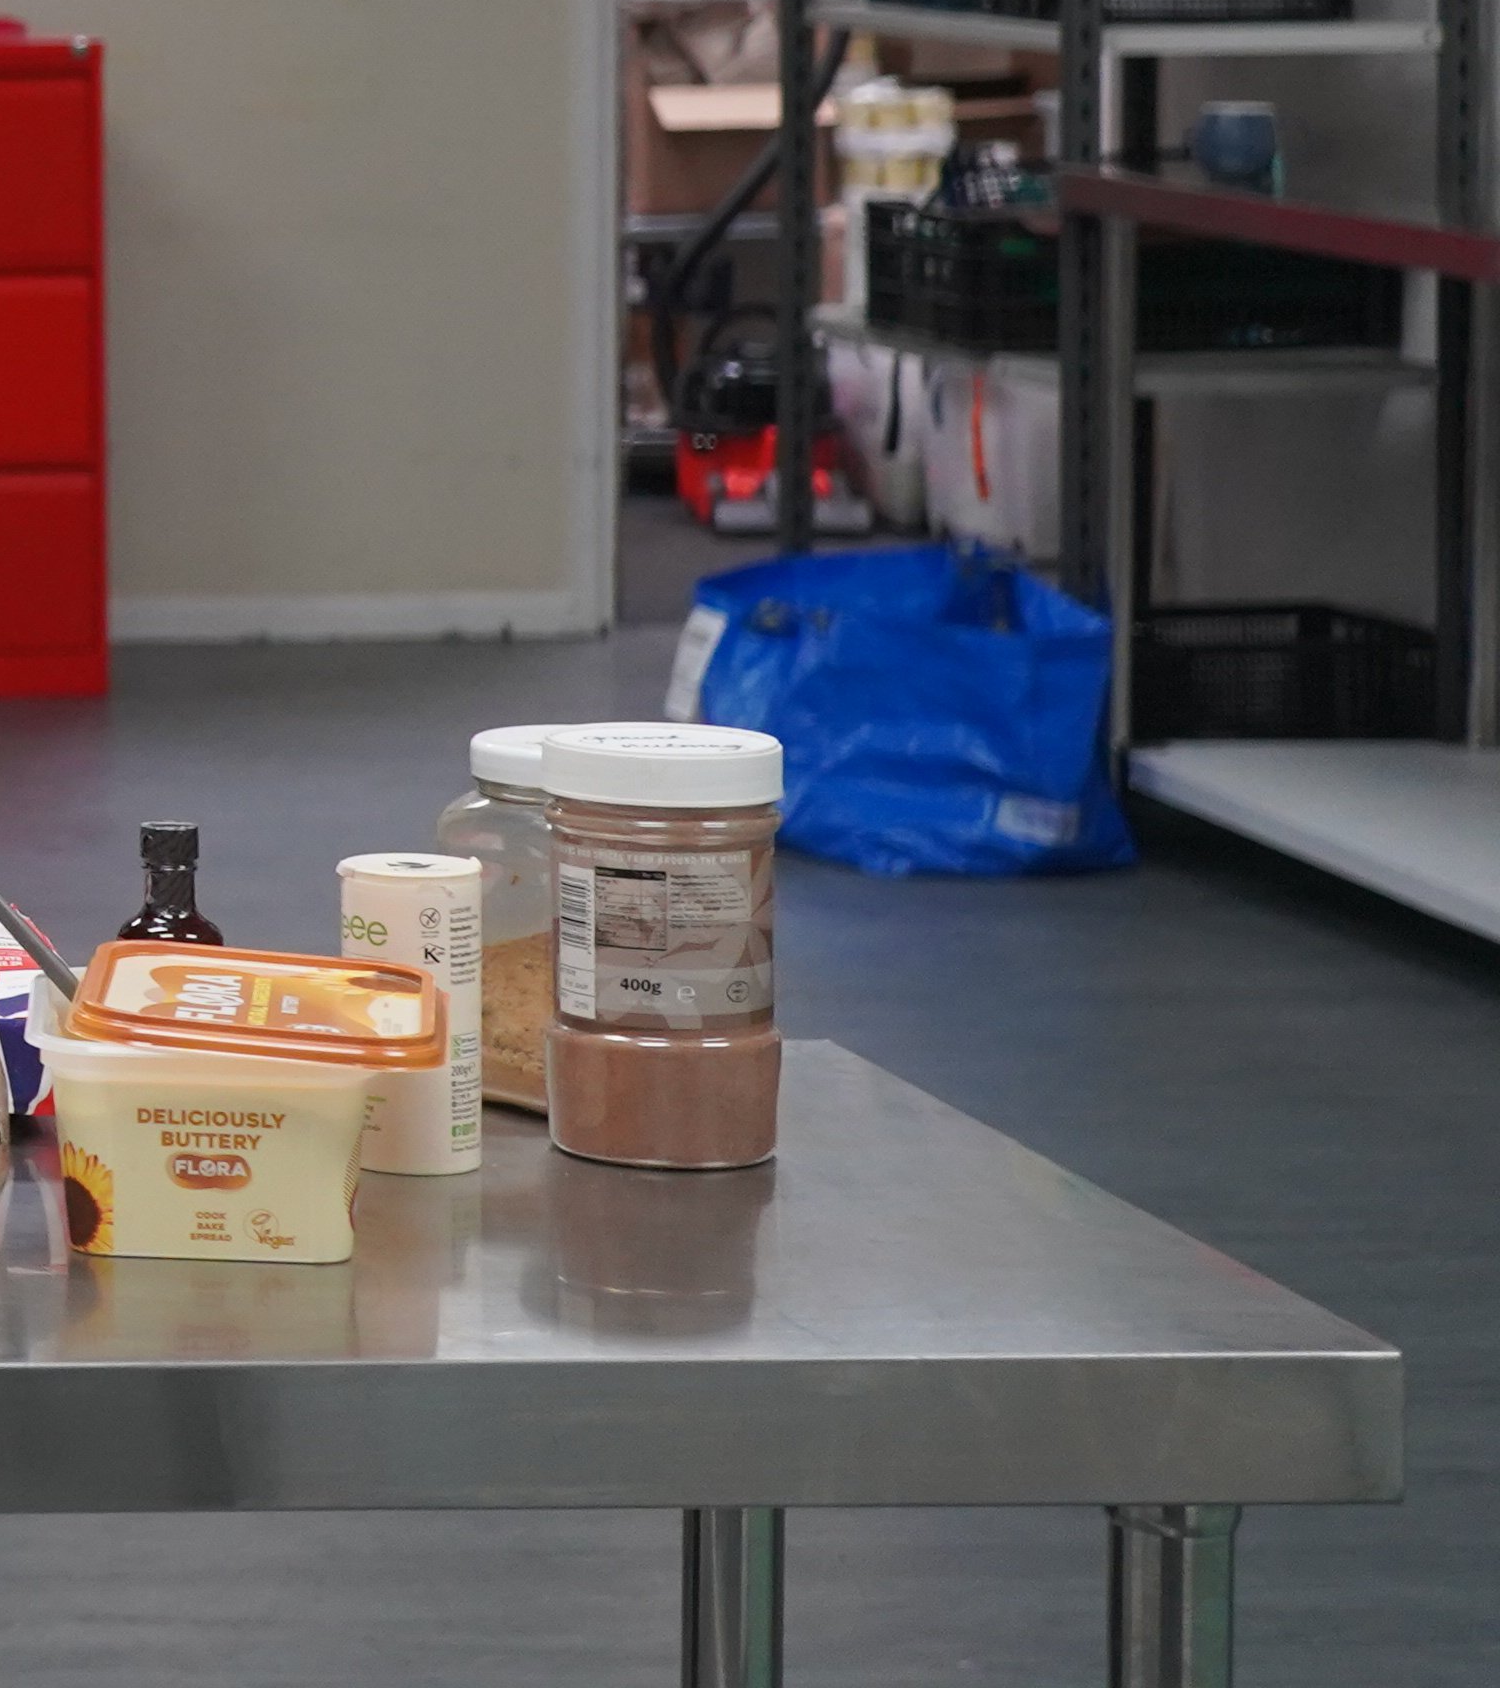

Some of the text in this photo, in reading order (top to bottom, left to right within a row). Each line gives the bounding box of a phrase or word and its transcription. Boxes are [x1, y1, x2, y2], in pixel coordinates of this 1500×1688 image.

[620, 978, 663, 995] 400g
[174, 973, 245, 1024] FLORA
[136, 1107, 286, 1130] DELICIOUSLY
[160, 1131, 263, 1151] BUTTERY
[174, 1159, 248, 1177] FLORA
